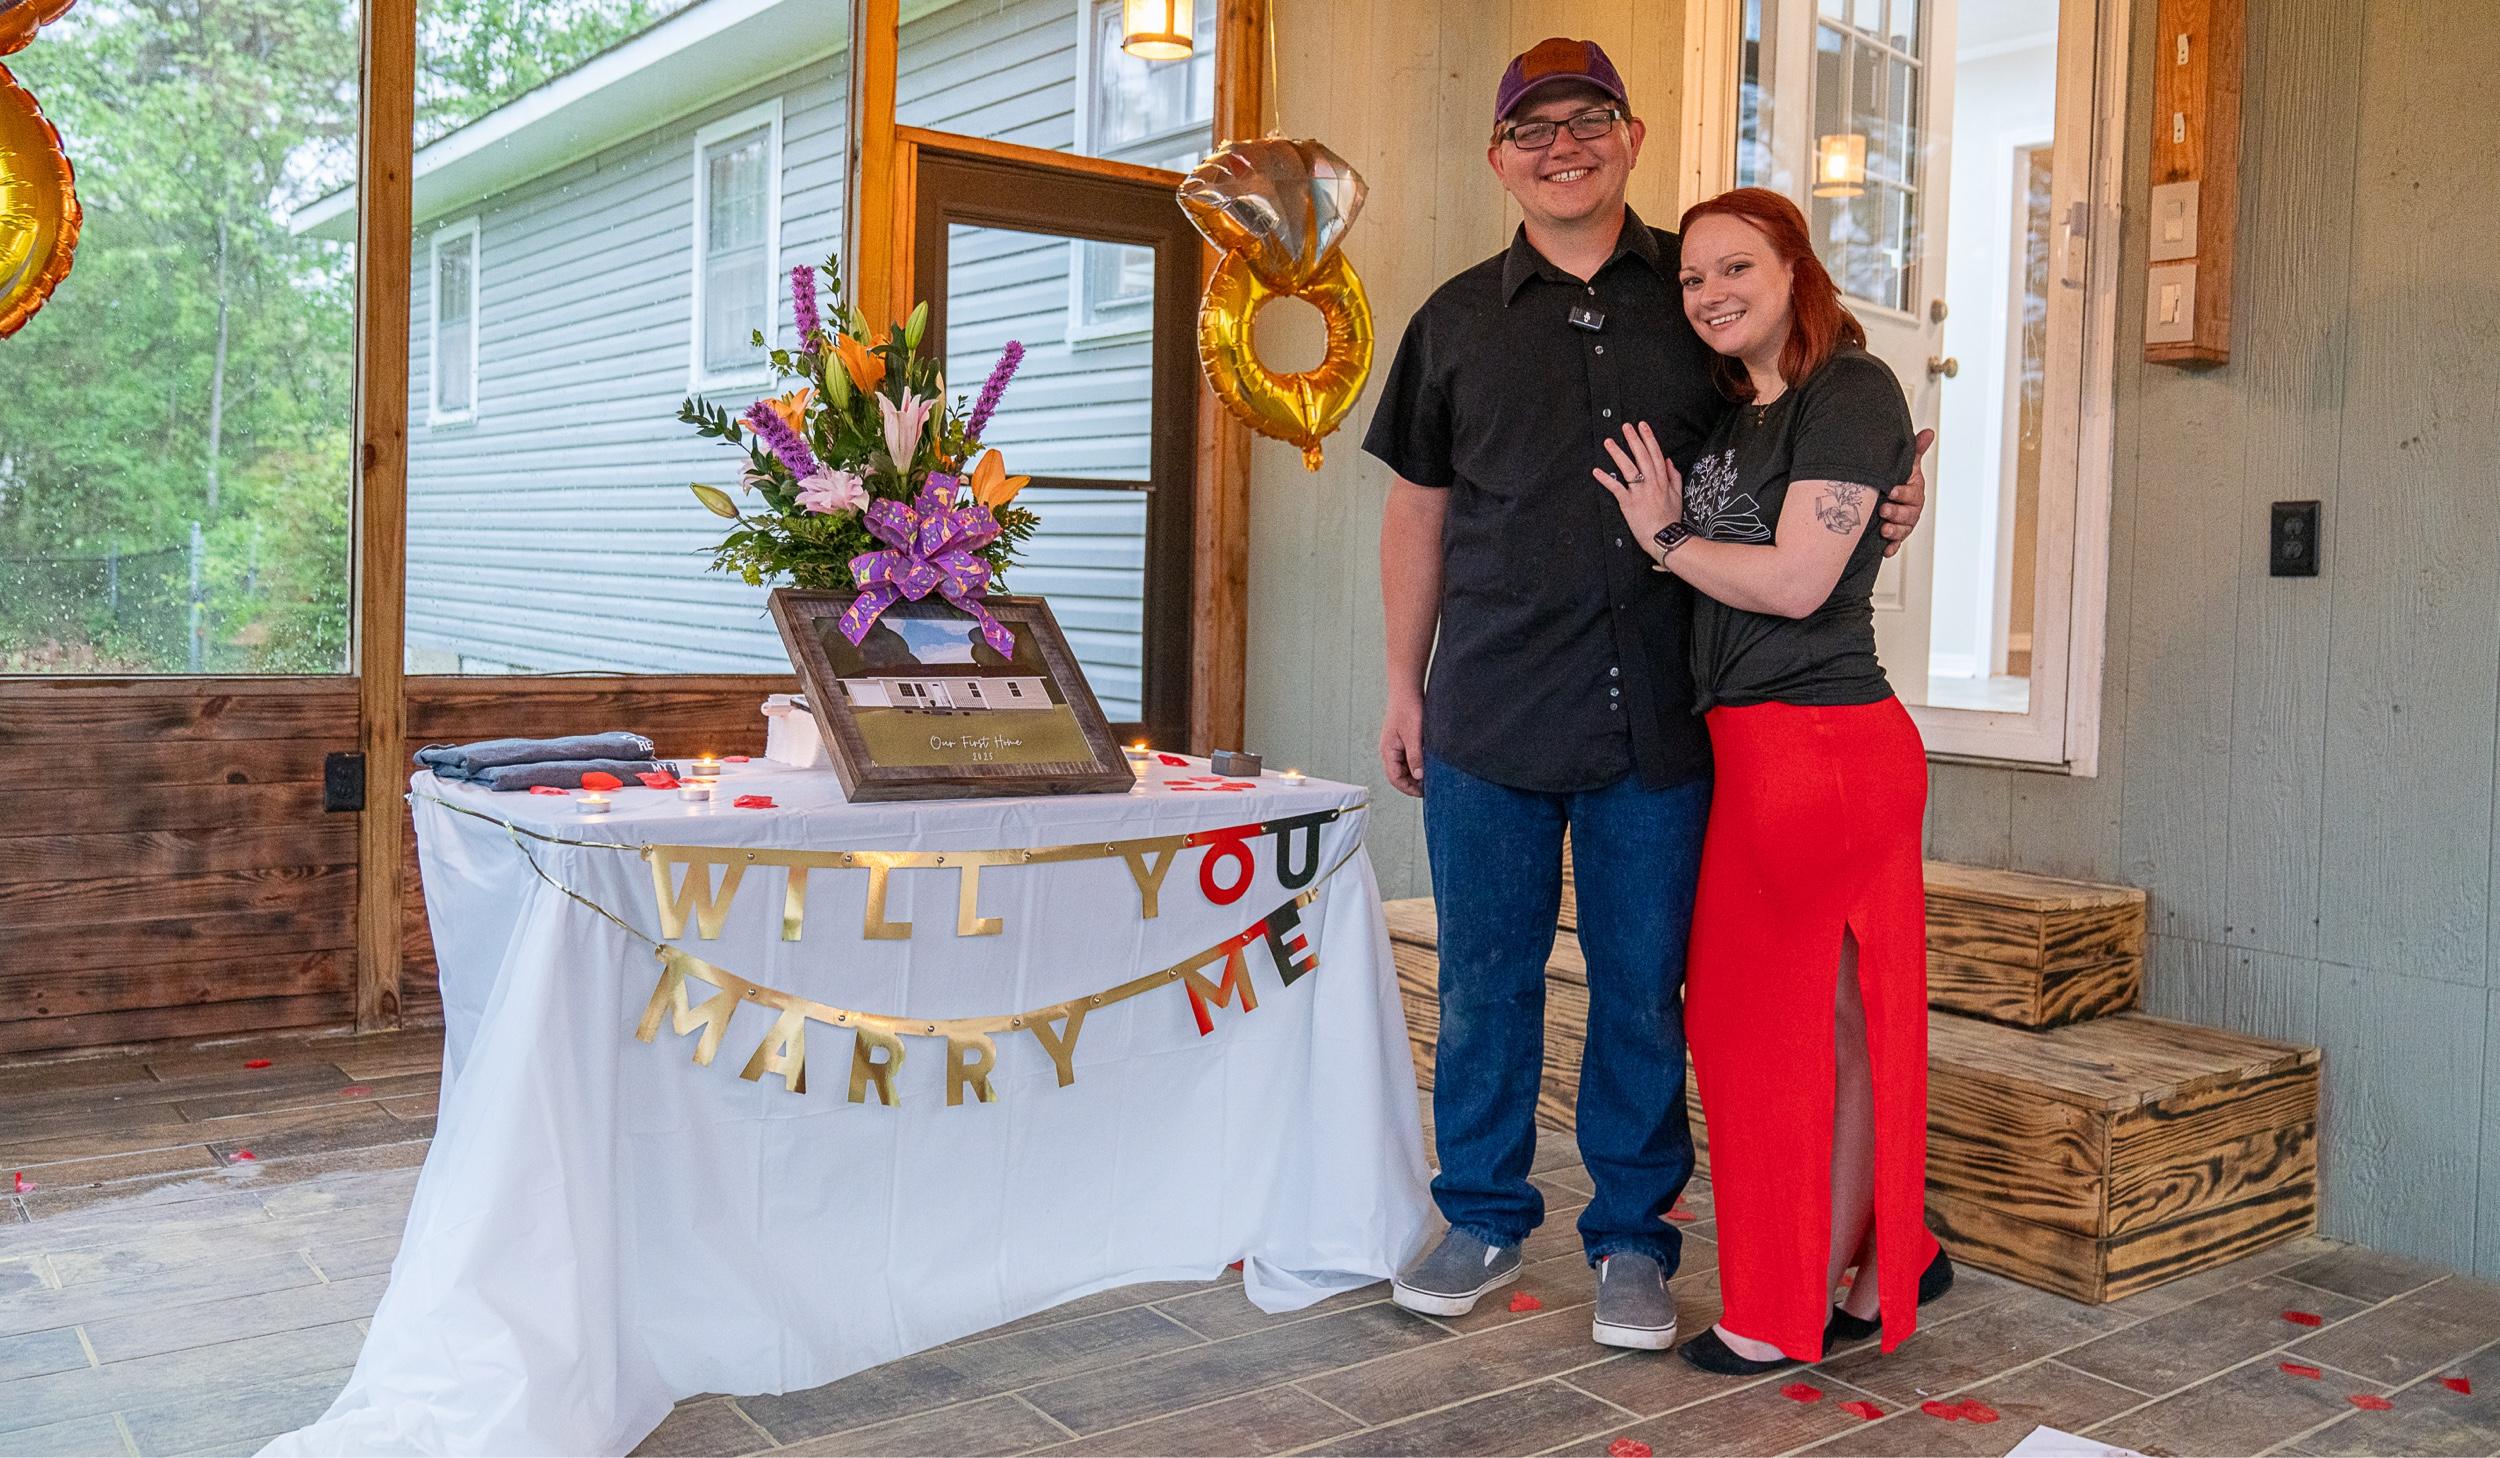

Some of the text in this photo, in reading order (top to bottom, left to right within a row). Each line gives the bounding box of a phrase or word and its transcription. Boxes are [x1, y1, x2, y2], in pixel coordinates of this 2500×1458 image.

[930, 734, 1023, 750] Our First Home
[649, 812, 1323, 941] WILL YOU
[634, 899, 1321, 1107] MARRY ME
